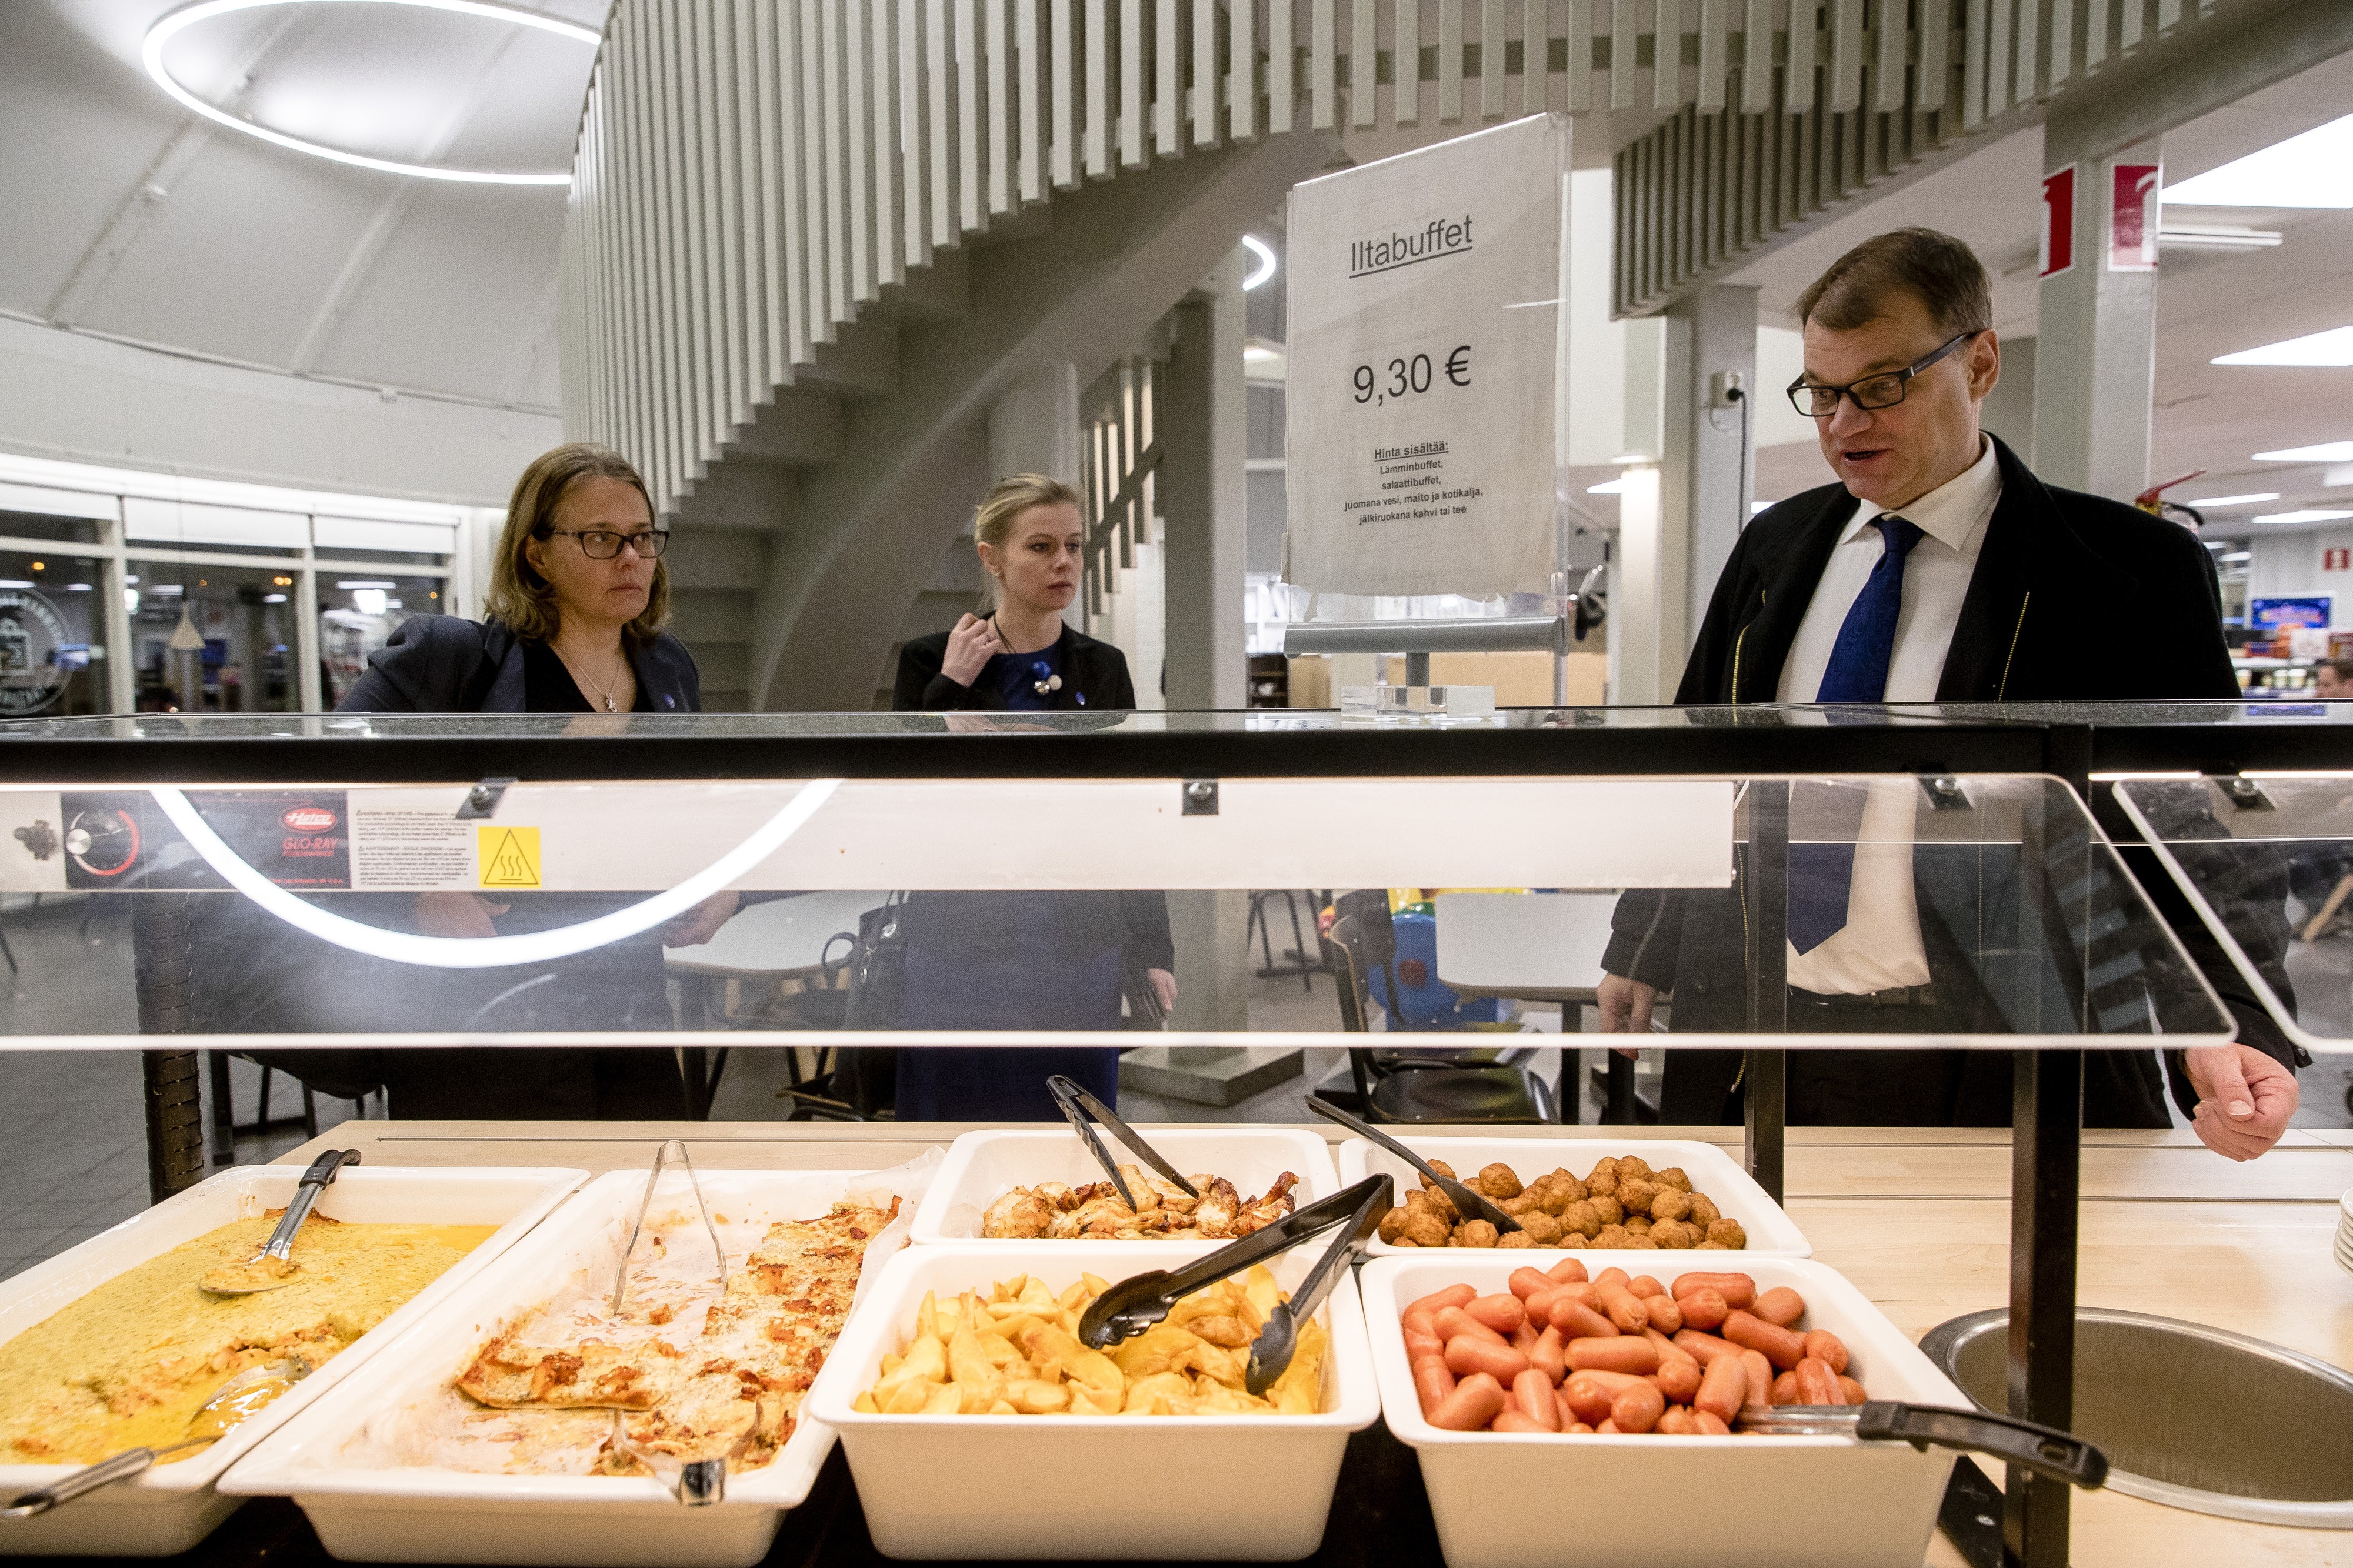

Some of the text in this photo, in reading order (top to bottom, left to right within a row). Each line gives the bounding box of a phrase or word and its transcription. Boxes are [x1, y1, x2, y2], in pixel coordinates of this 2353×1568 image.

[1351, 214, 1472, 273] Iltabuffet
[1354, 345, 1471, 407] 9,30 €
[1374, 441, 1448, 459] Hinta sisältää:
[1379, 459, 1443, 475] Lämminbuffet,
[1382, 476, 1441, 490] salaattibuffet,
[1344, 487, 1483, 512] juomana vesi, maito ja kotikalja,
[1359, 506, 1467, 525] jälkiruokana kahvi tai tee
[286, 812, 332, 823] Hatco
